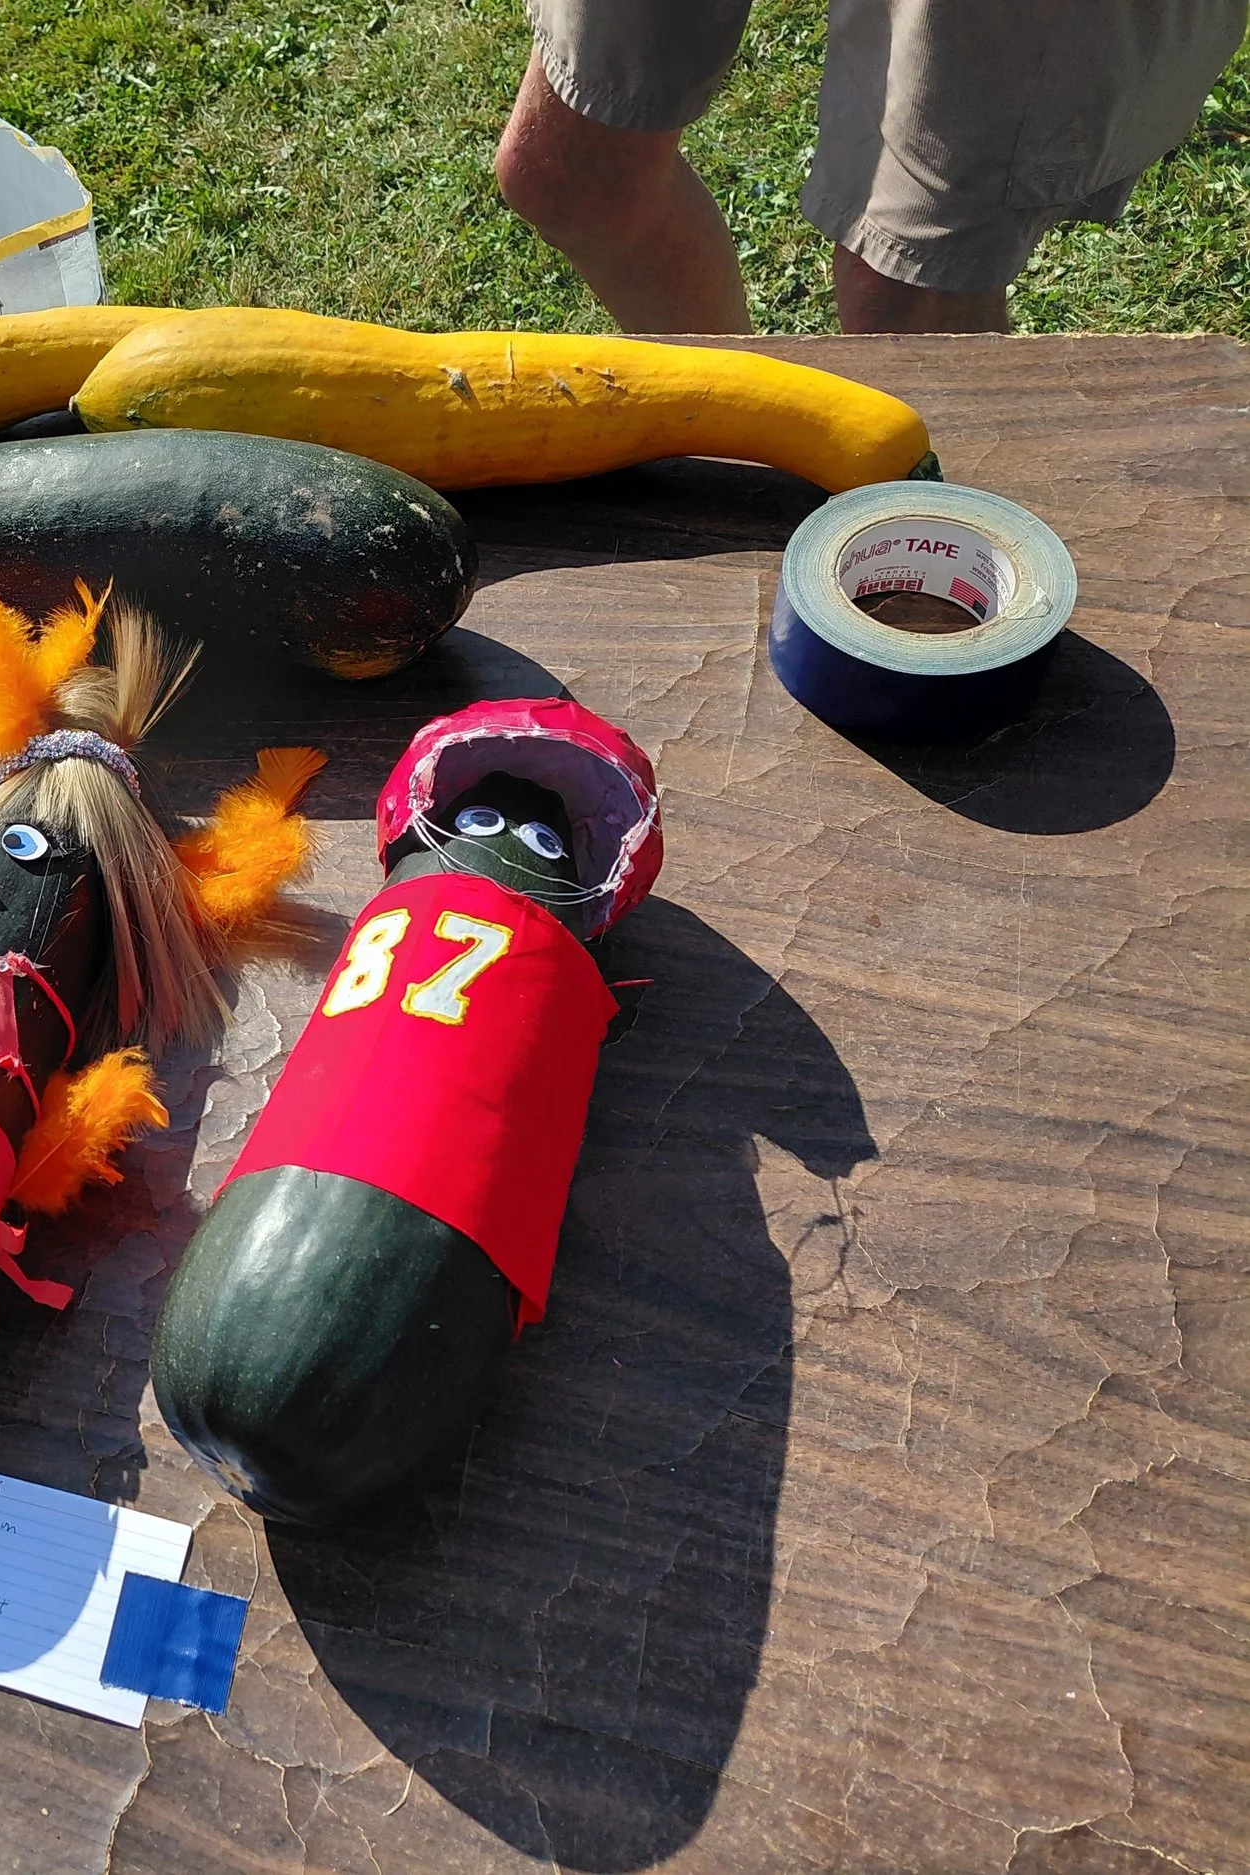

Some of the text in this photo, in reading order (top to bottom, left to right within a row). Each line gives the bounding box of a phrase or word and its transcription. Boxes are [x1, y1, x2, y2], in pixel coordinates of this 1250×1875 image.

[905, 538, 960, 559] TAPE
[856, 578, 924, 597] BERRY
[322, 908, 514, 1025] 87
